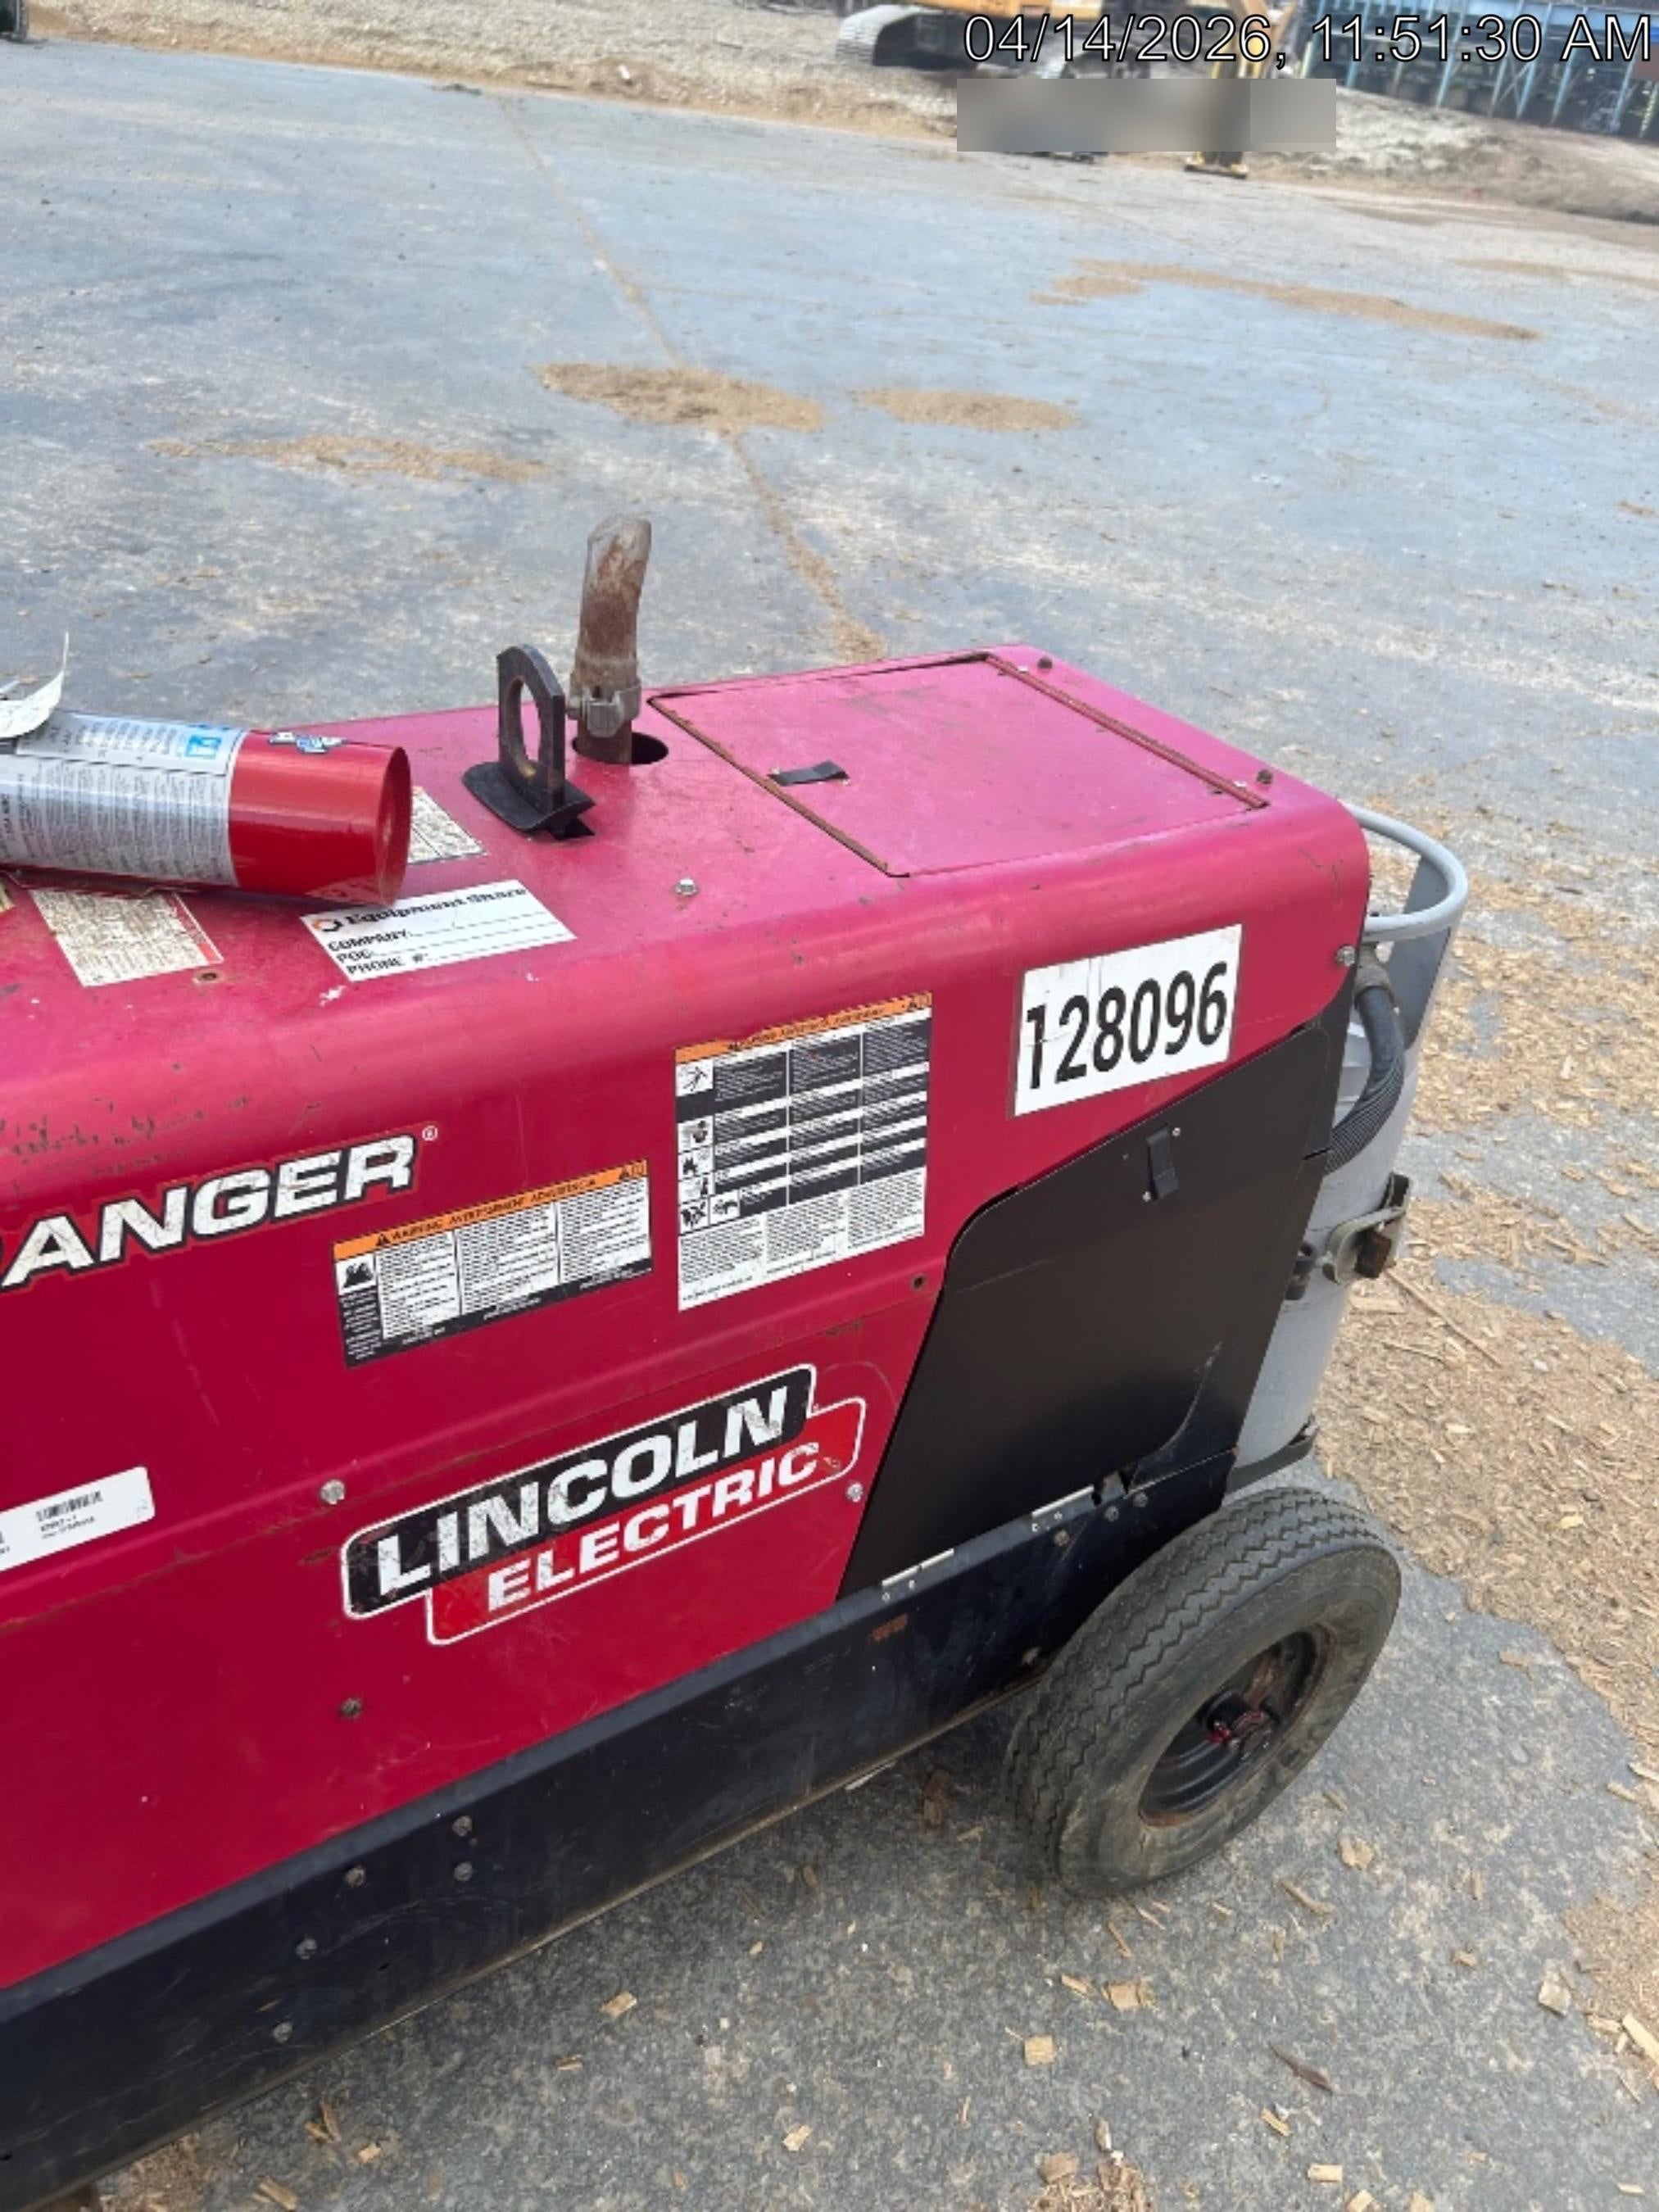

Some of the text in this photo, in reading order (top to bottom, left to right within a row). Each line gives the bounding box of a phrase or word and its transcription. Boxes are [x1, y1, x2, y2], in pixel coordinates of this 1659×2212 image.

[1027, 961, 1227, 1090] 128096
[376, 1386, 788, 1596] LINCOLN
[487, 1441, 820, 1611] ELECTRIC
